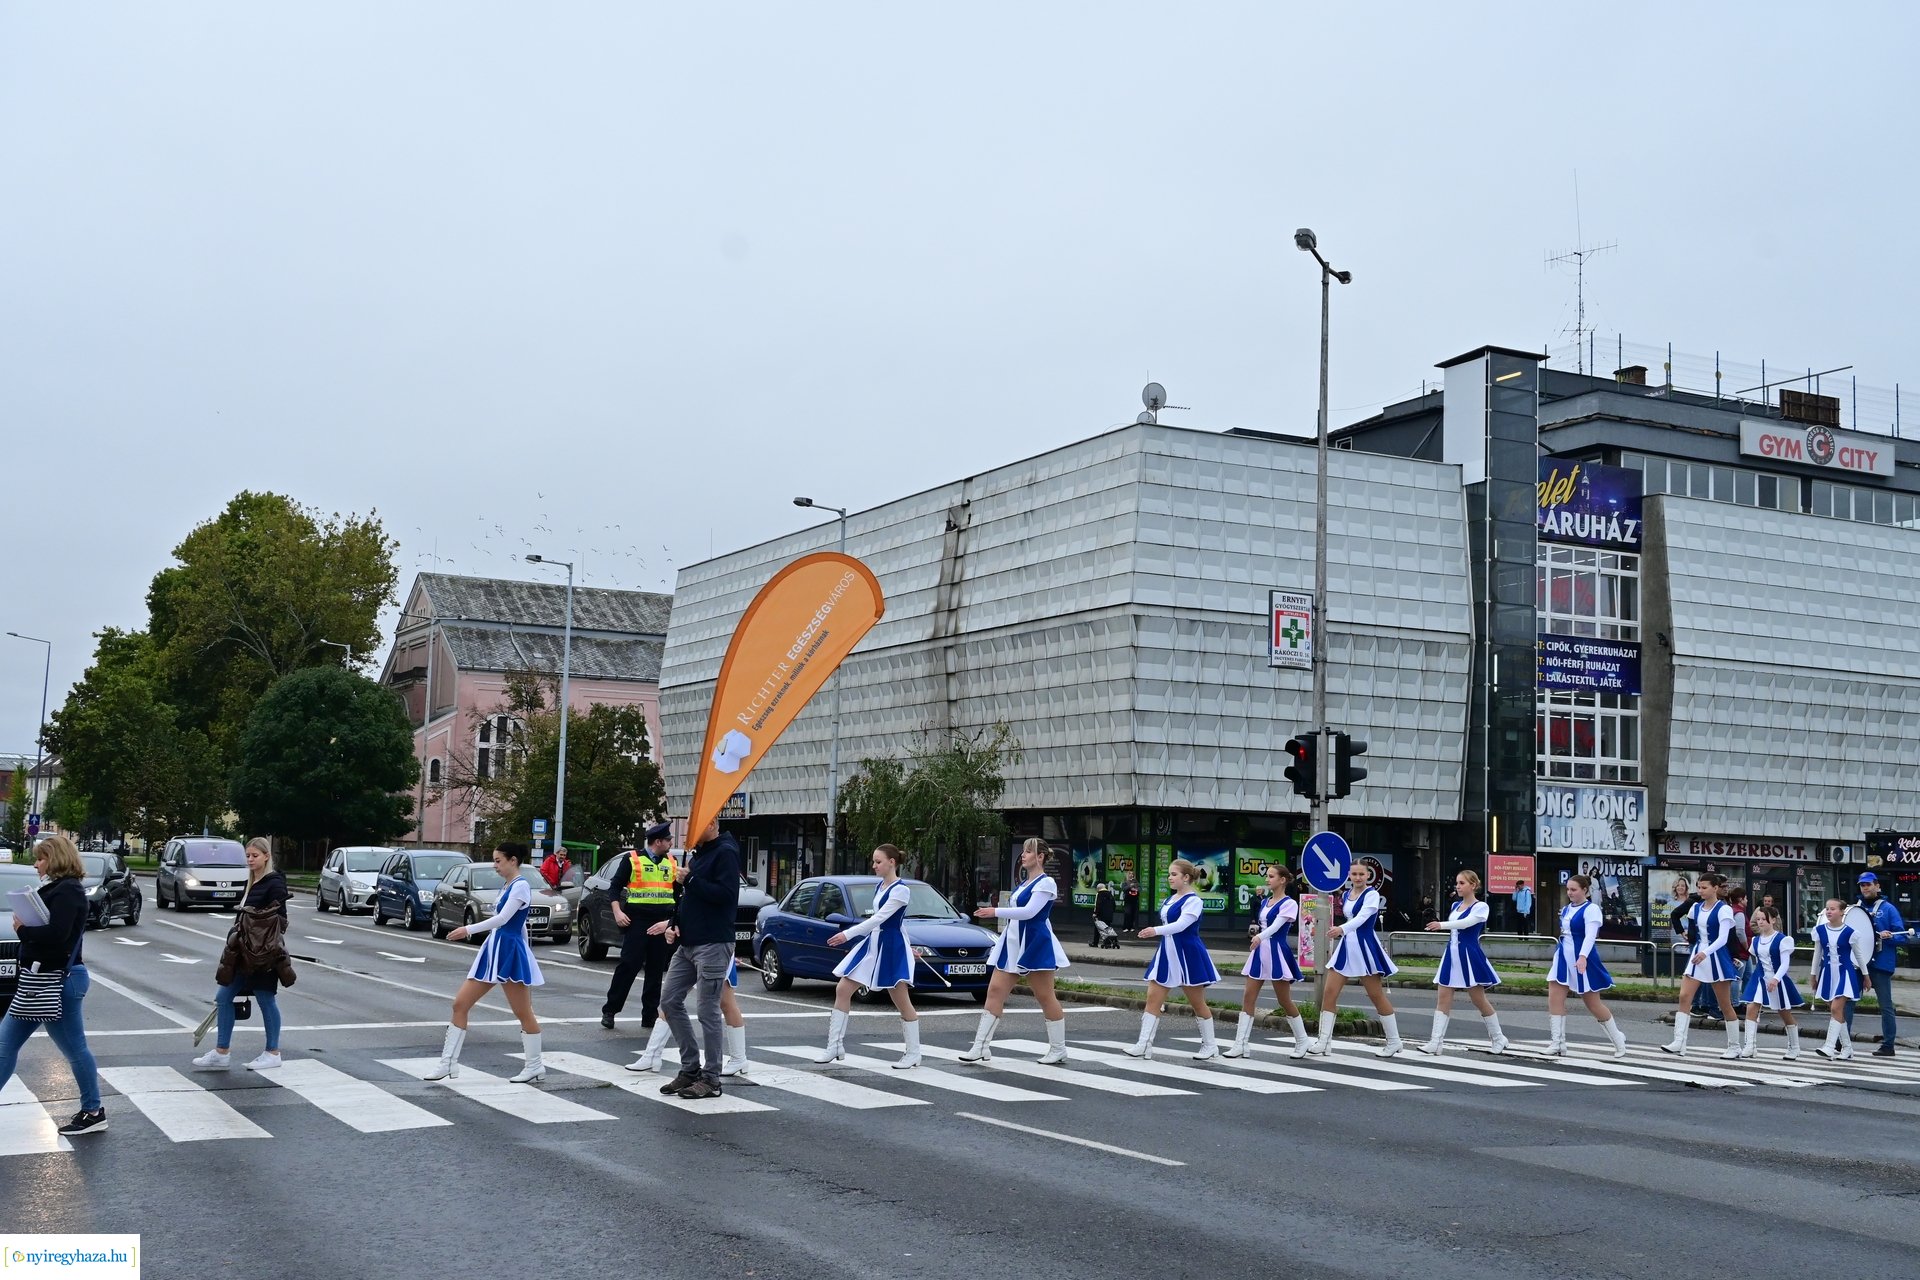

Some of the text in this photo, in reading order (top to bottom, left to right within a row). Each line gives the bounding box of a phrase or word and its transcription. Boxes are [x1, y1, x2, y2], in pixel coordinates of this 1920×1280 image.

[1759, 434, 1802, 460] GYM
[1838, 446, 1878, 471] CITY
[1538, 464, 1580, 508] elet
[1543, 503, 1639, 544] ÁRUHÁZ
[736, 570, 855, 725] RICHTER EGÉSZSÉGVÁROS
[1546, 641, 1572, 654] CIPŐK,
[1573, 644, 1638, 658] GYEREKRUHÁZAT
[1585, 660, 1621, 672] RUHÁZAT
[1599, 677, 1622, 688] JÁTÉK
[1582, 794, 1638, 822] KONG
[1887, 850, 1897, 862] és
